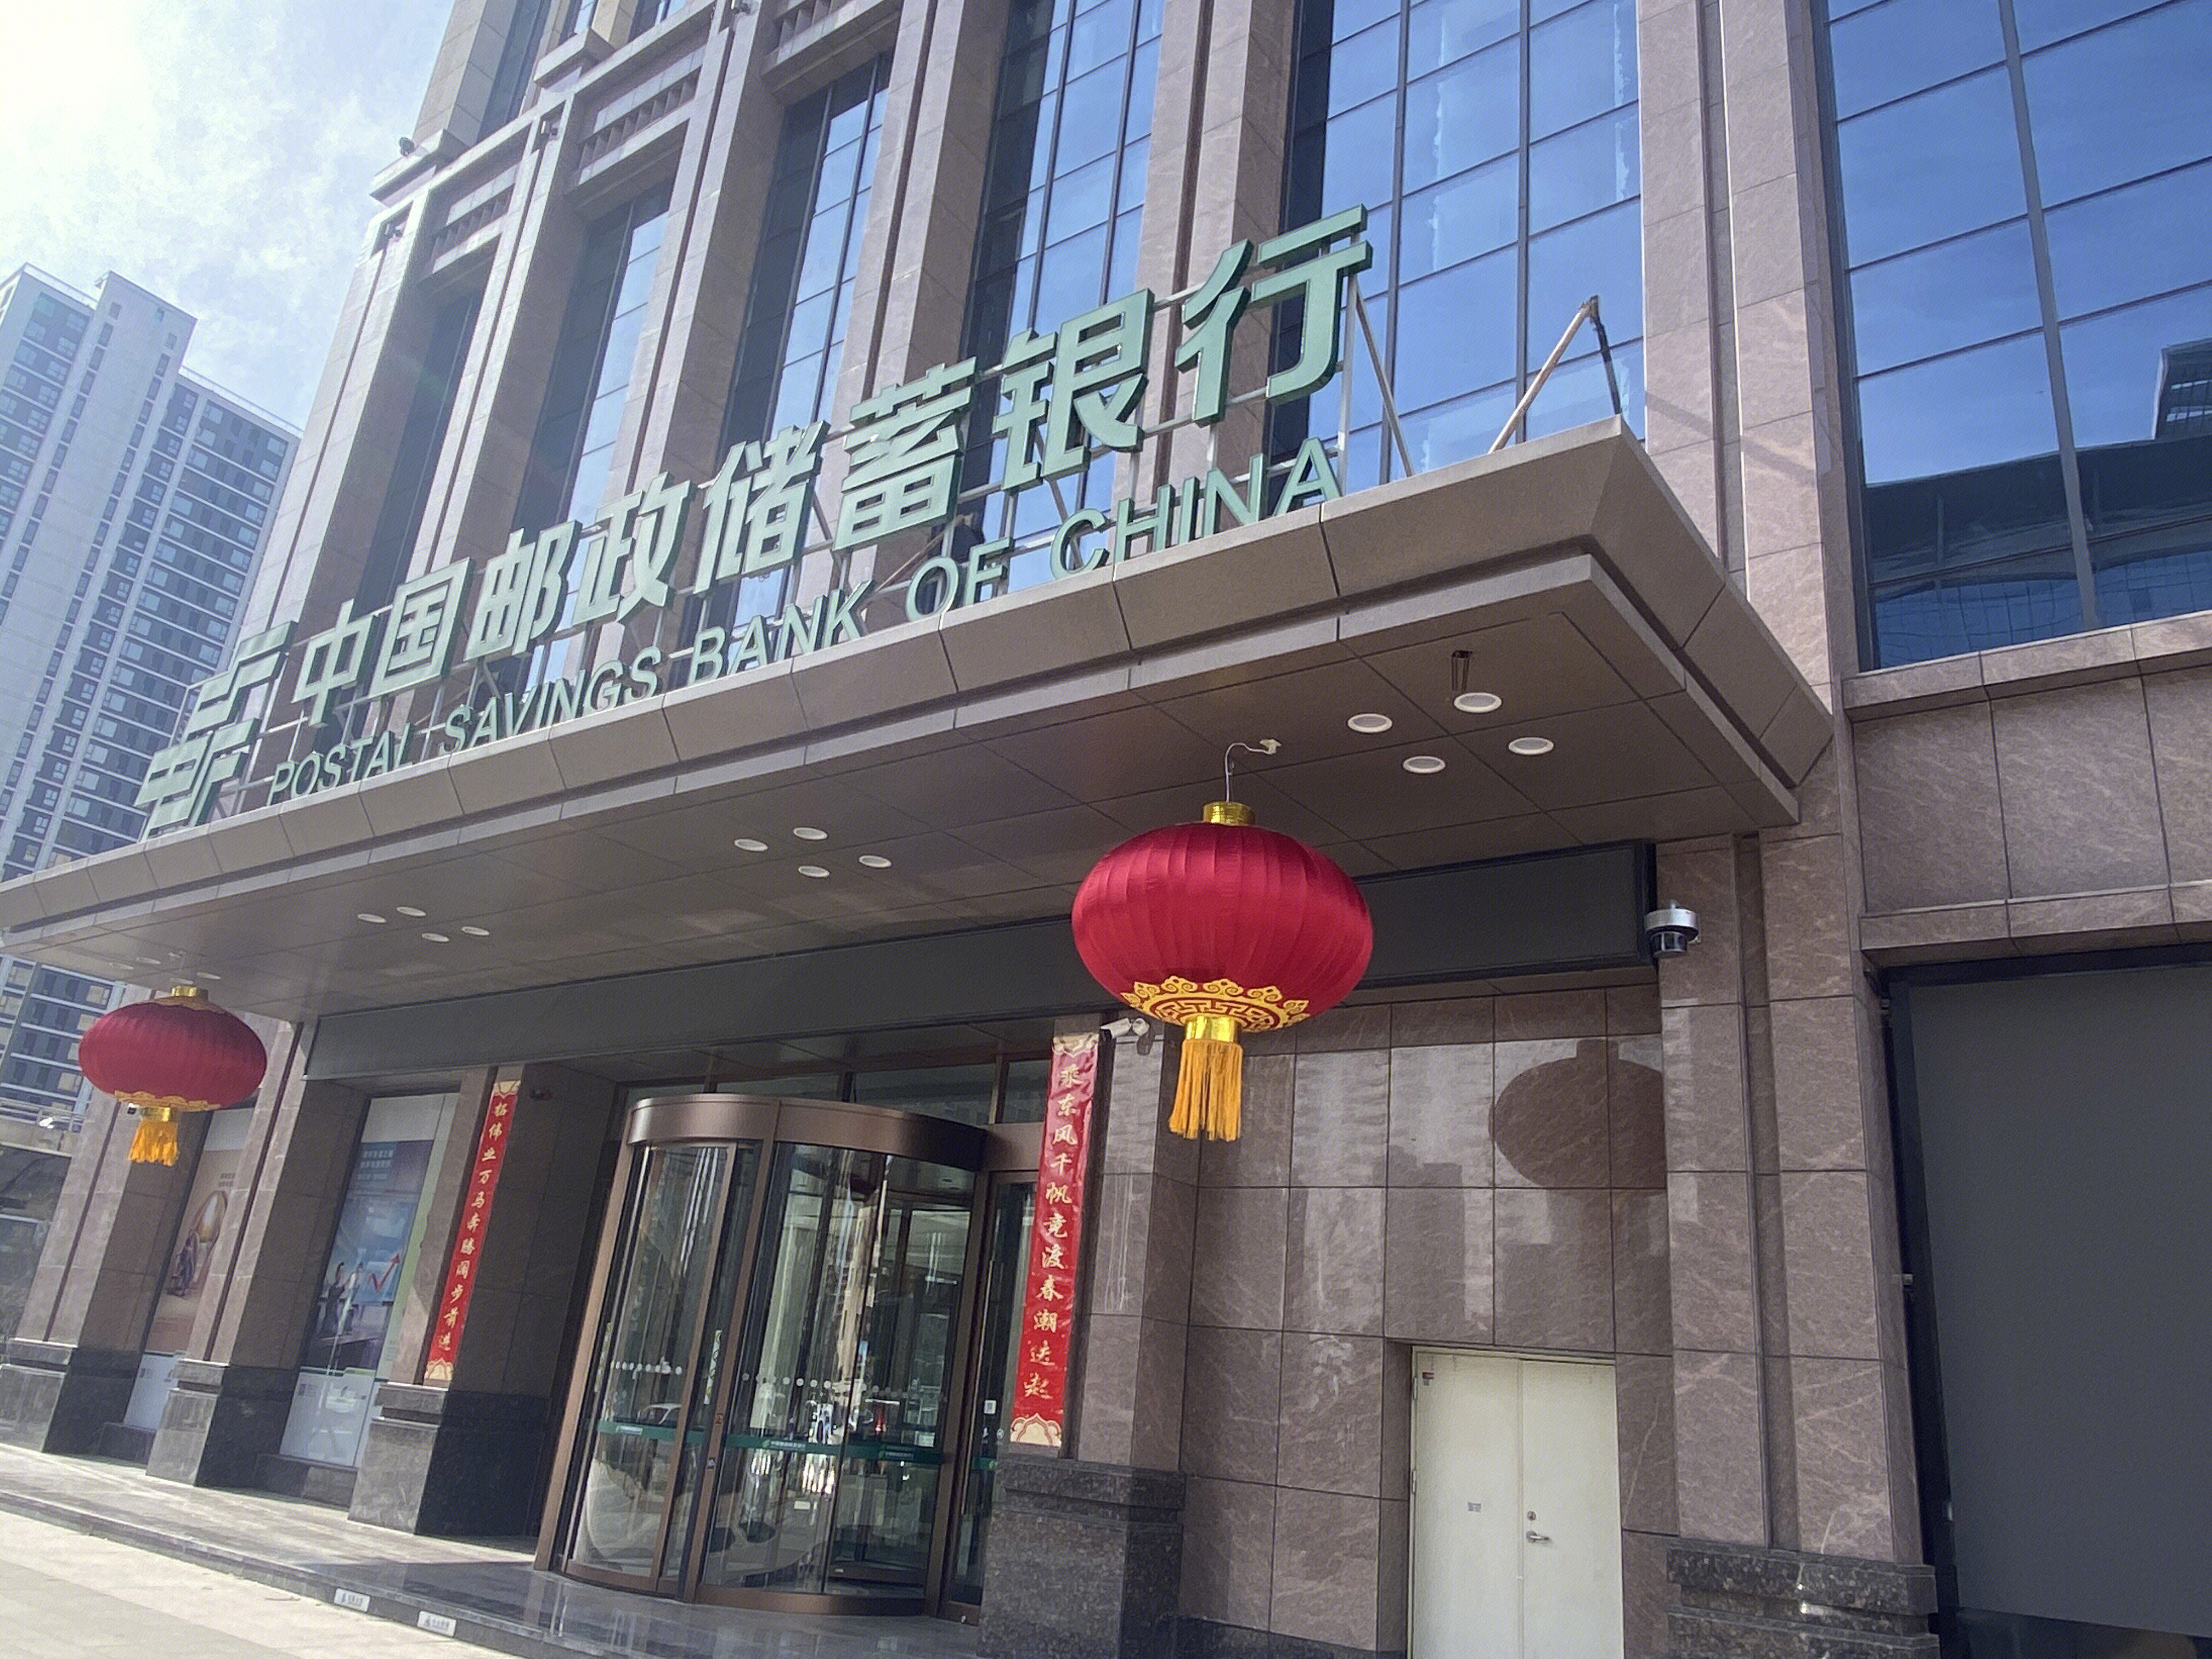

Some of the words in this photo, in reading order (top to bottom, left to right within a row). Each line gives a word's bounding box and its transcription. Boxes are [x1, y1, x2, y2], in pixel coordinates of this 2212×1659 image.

[267, 723, 415, 806] POSTAL
[439, 646, 662, 755] SAVINGS
[688, 580, 874, 686] BANK
[904, 537, 1014, 621] OF
[1049, 437, 1343, 582] CHINA
[291, 204, 1373, 728] 中国邮政储蓄银行
